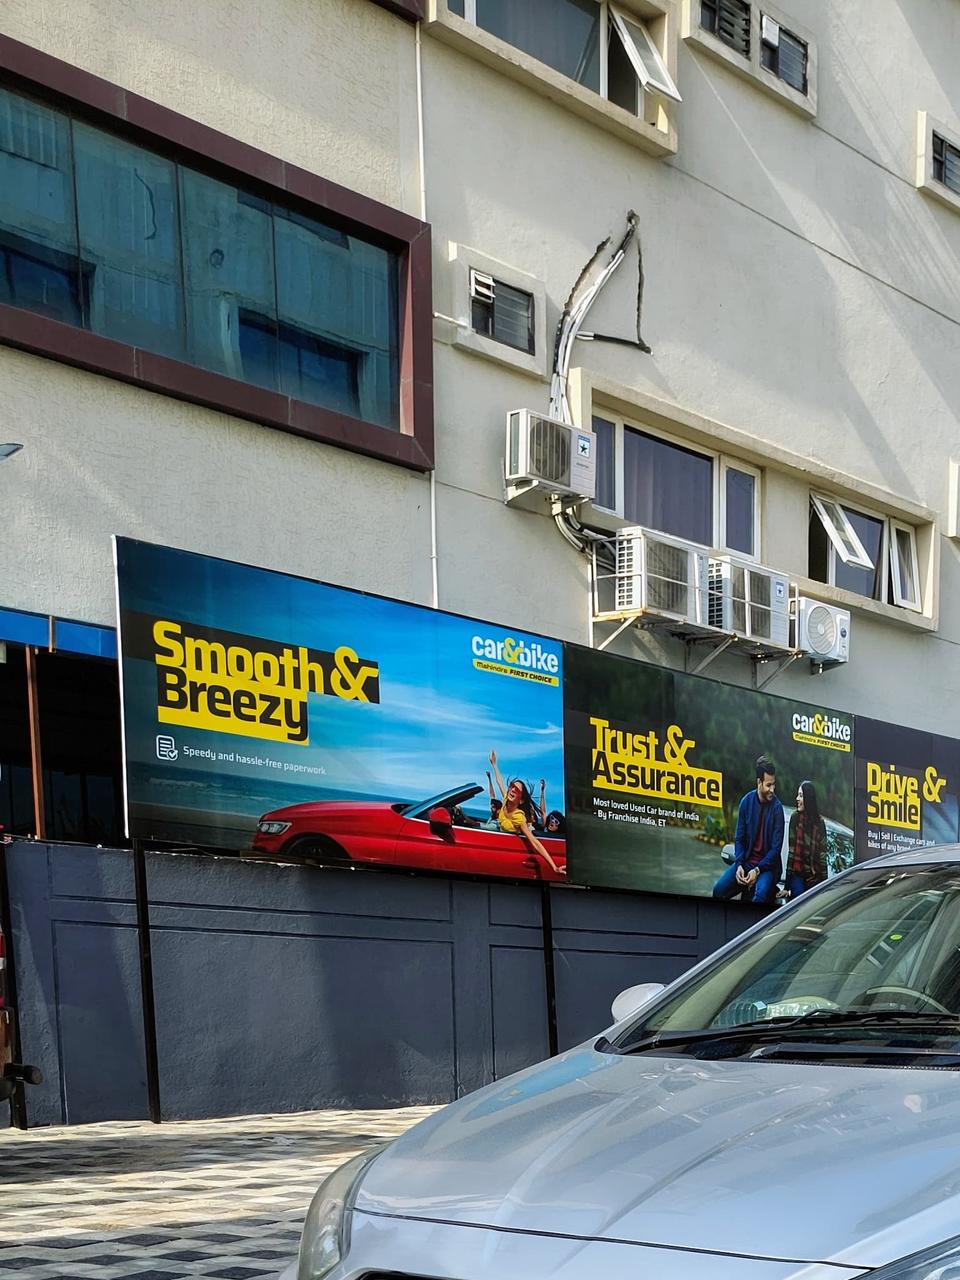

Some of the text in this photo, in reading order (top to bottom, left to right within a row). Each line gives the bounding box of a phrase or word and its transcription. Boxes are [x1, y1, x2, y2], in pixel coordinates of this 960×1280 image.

[153, 620, 379, 703] Smooth &
[472, 636, 558, 673] car&bike
[510, 669, 529, 678] FIRST
[529, 673, 552, 684] CHOICE
[157, 667, 308, 741] Breezy
[590, 717, 696, 768] Trust &
[792, 713, 851, 741] car&bike
[183, 746, 327, 775] Speedy and hassle-free paperwork
[592, 750, 720, 802] Assurance
[867, 762, 947, 803] Drive &
[593, 797, 700, 821] Most loved Used Car brand of India
[597, 809, 607, 820] By
[608, 811, 639, 823] Franchise
[640, 816, 657, 827] India,
[658, 818, 667, 828] ET
[867, 790, 919, 825] Smile
[868, 830, 878, 840] Buy
[881, 832, 891, 840] Sell
[894, 834, 915, 845] Exchange
[868, 840, 880, 849] bikes
[881, 842, 886, 850] of
[887, 844, 896, 853] any
